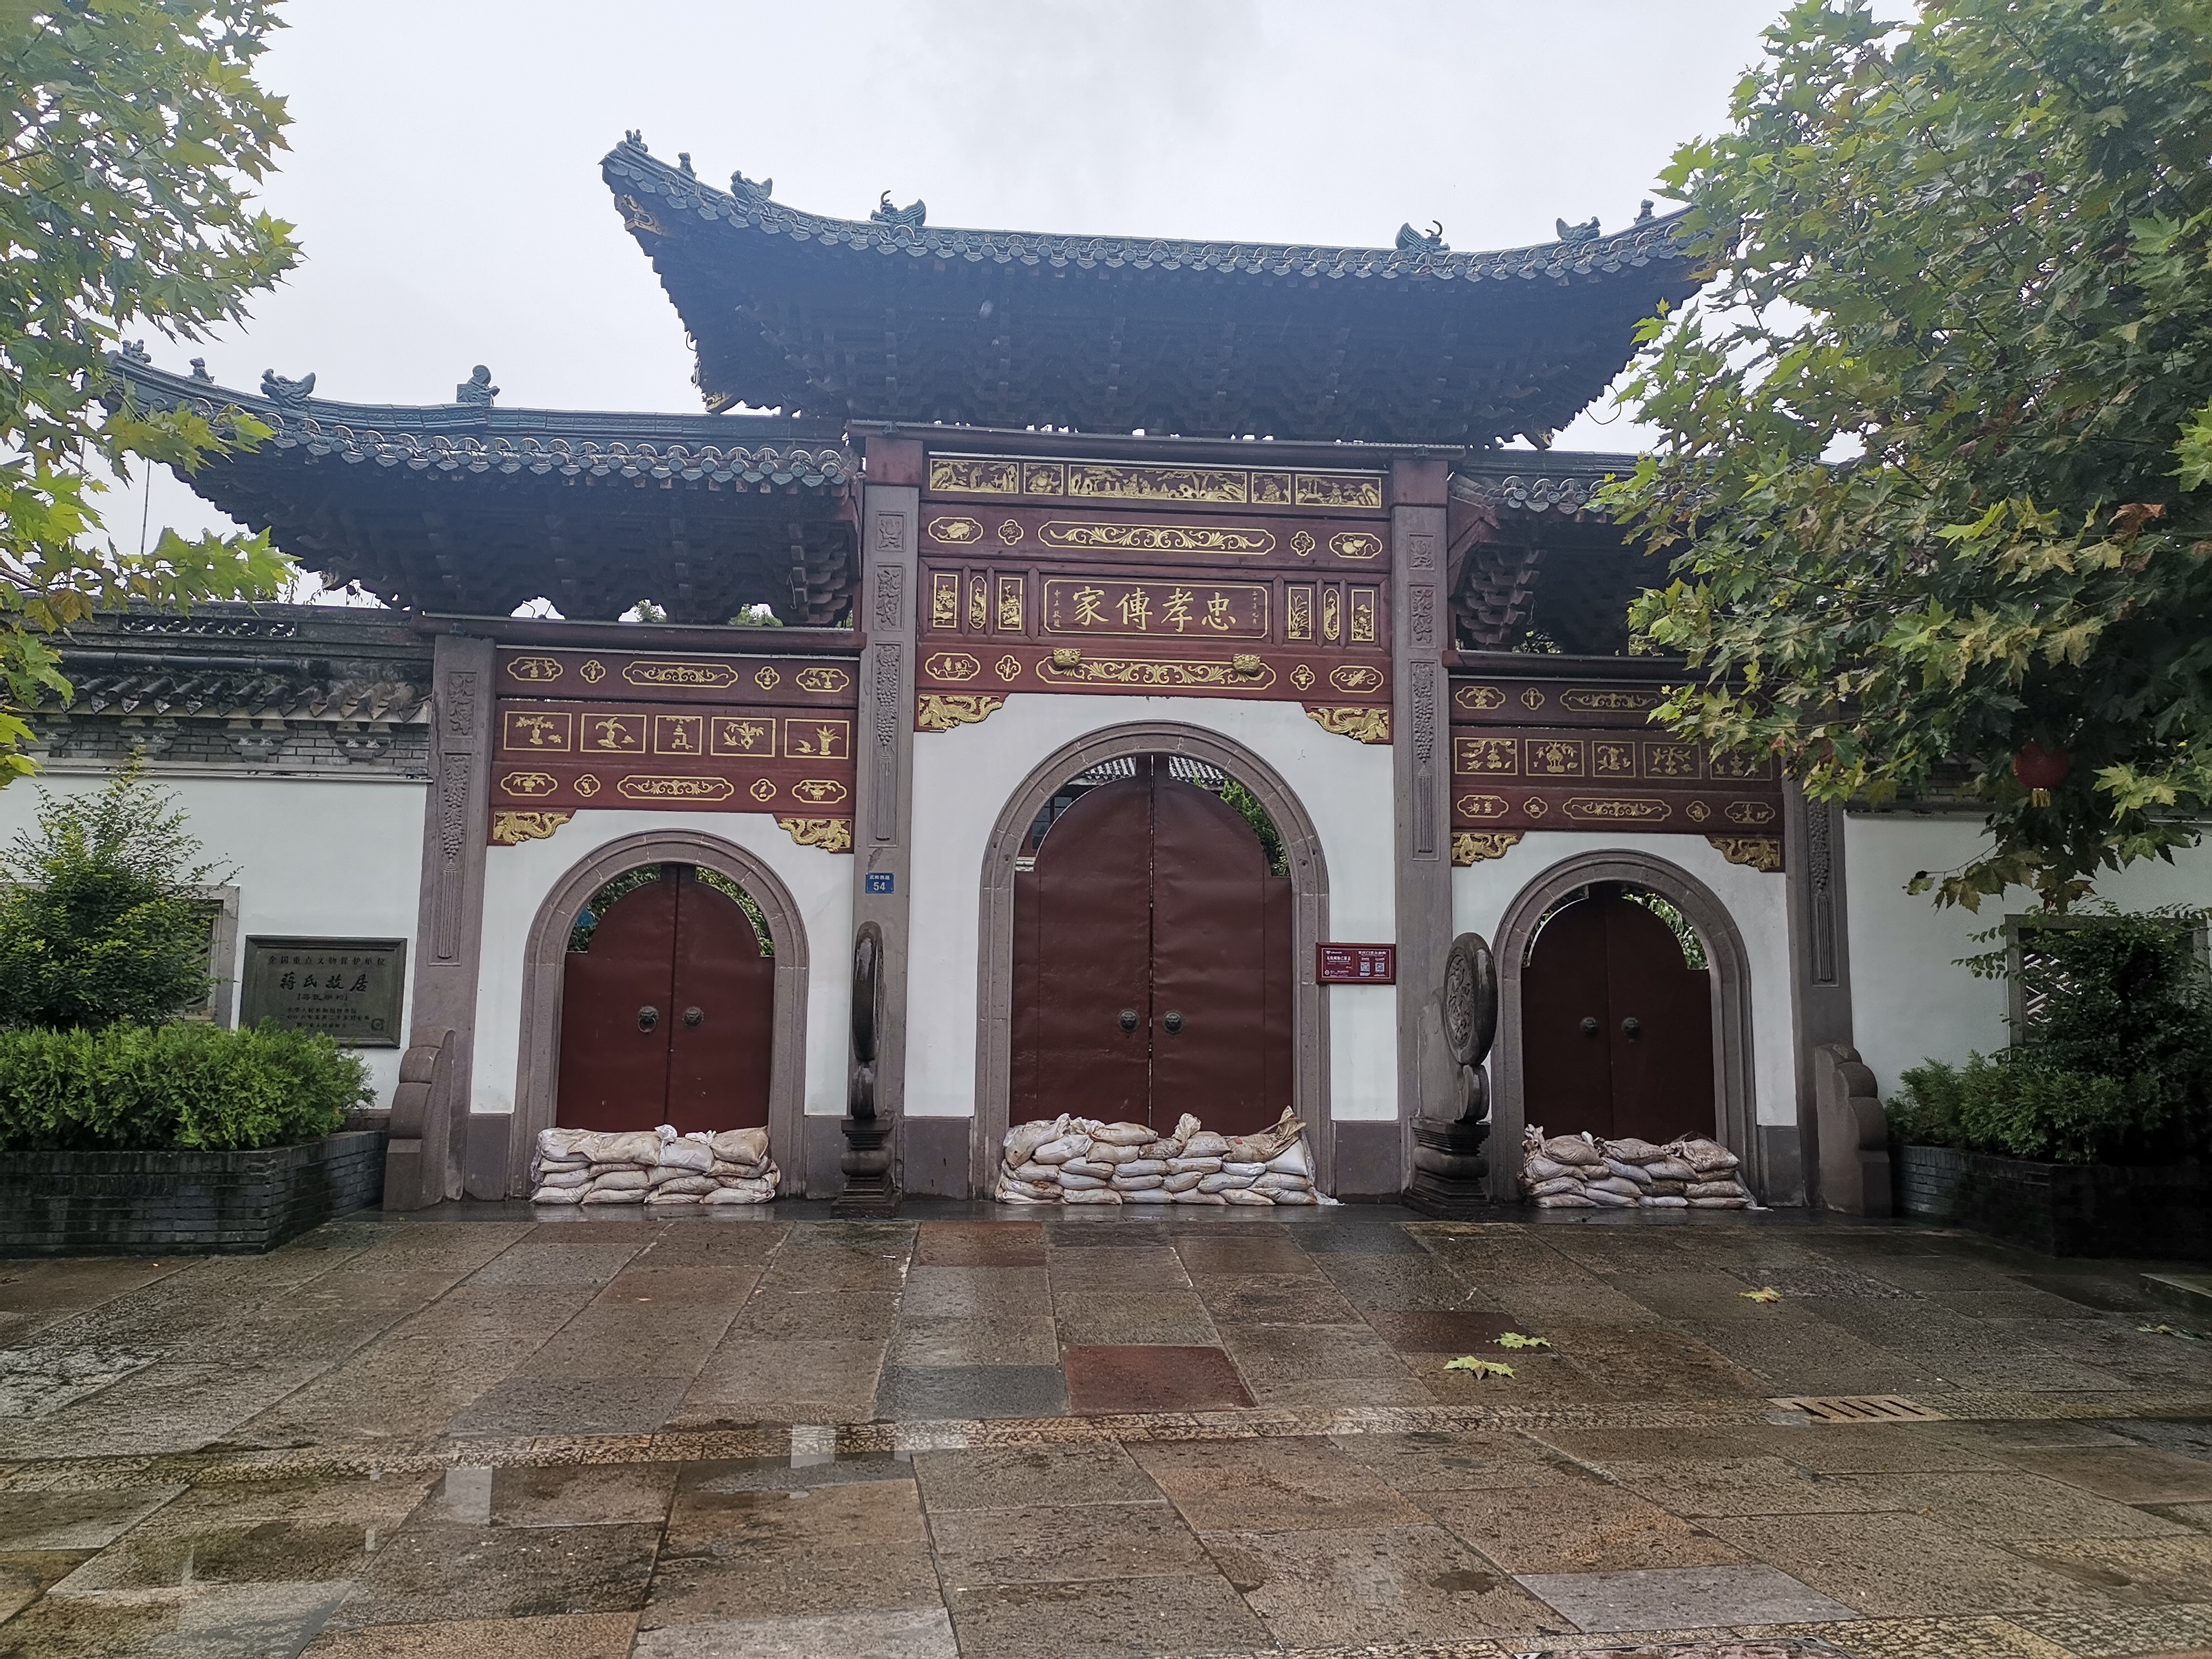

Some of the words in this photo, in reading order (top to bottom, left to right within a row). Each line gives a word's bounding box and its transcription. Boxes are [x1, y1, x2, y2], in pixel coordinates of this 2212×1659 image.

[873, 881, 886, 891] 54
[268, 955, 386, 966] 全国重点文物保护单位
